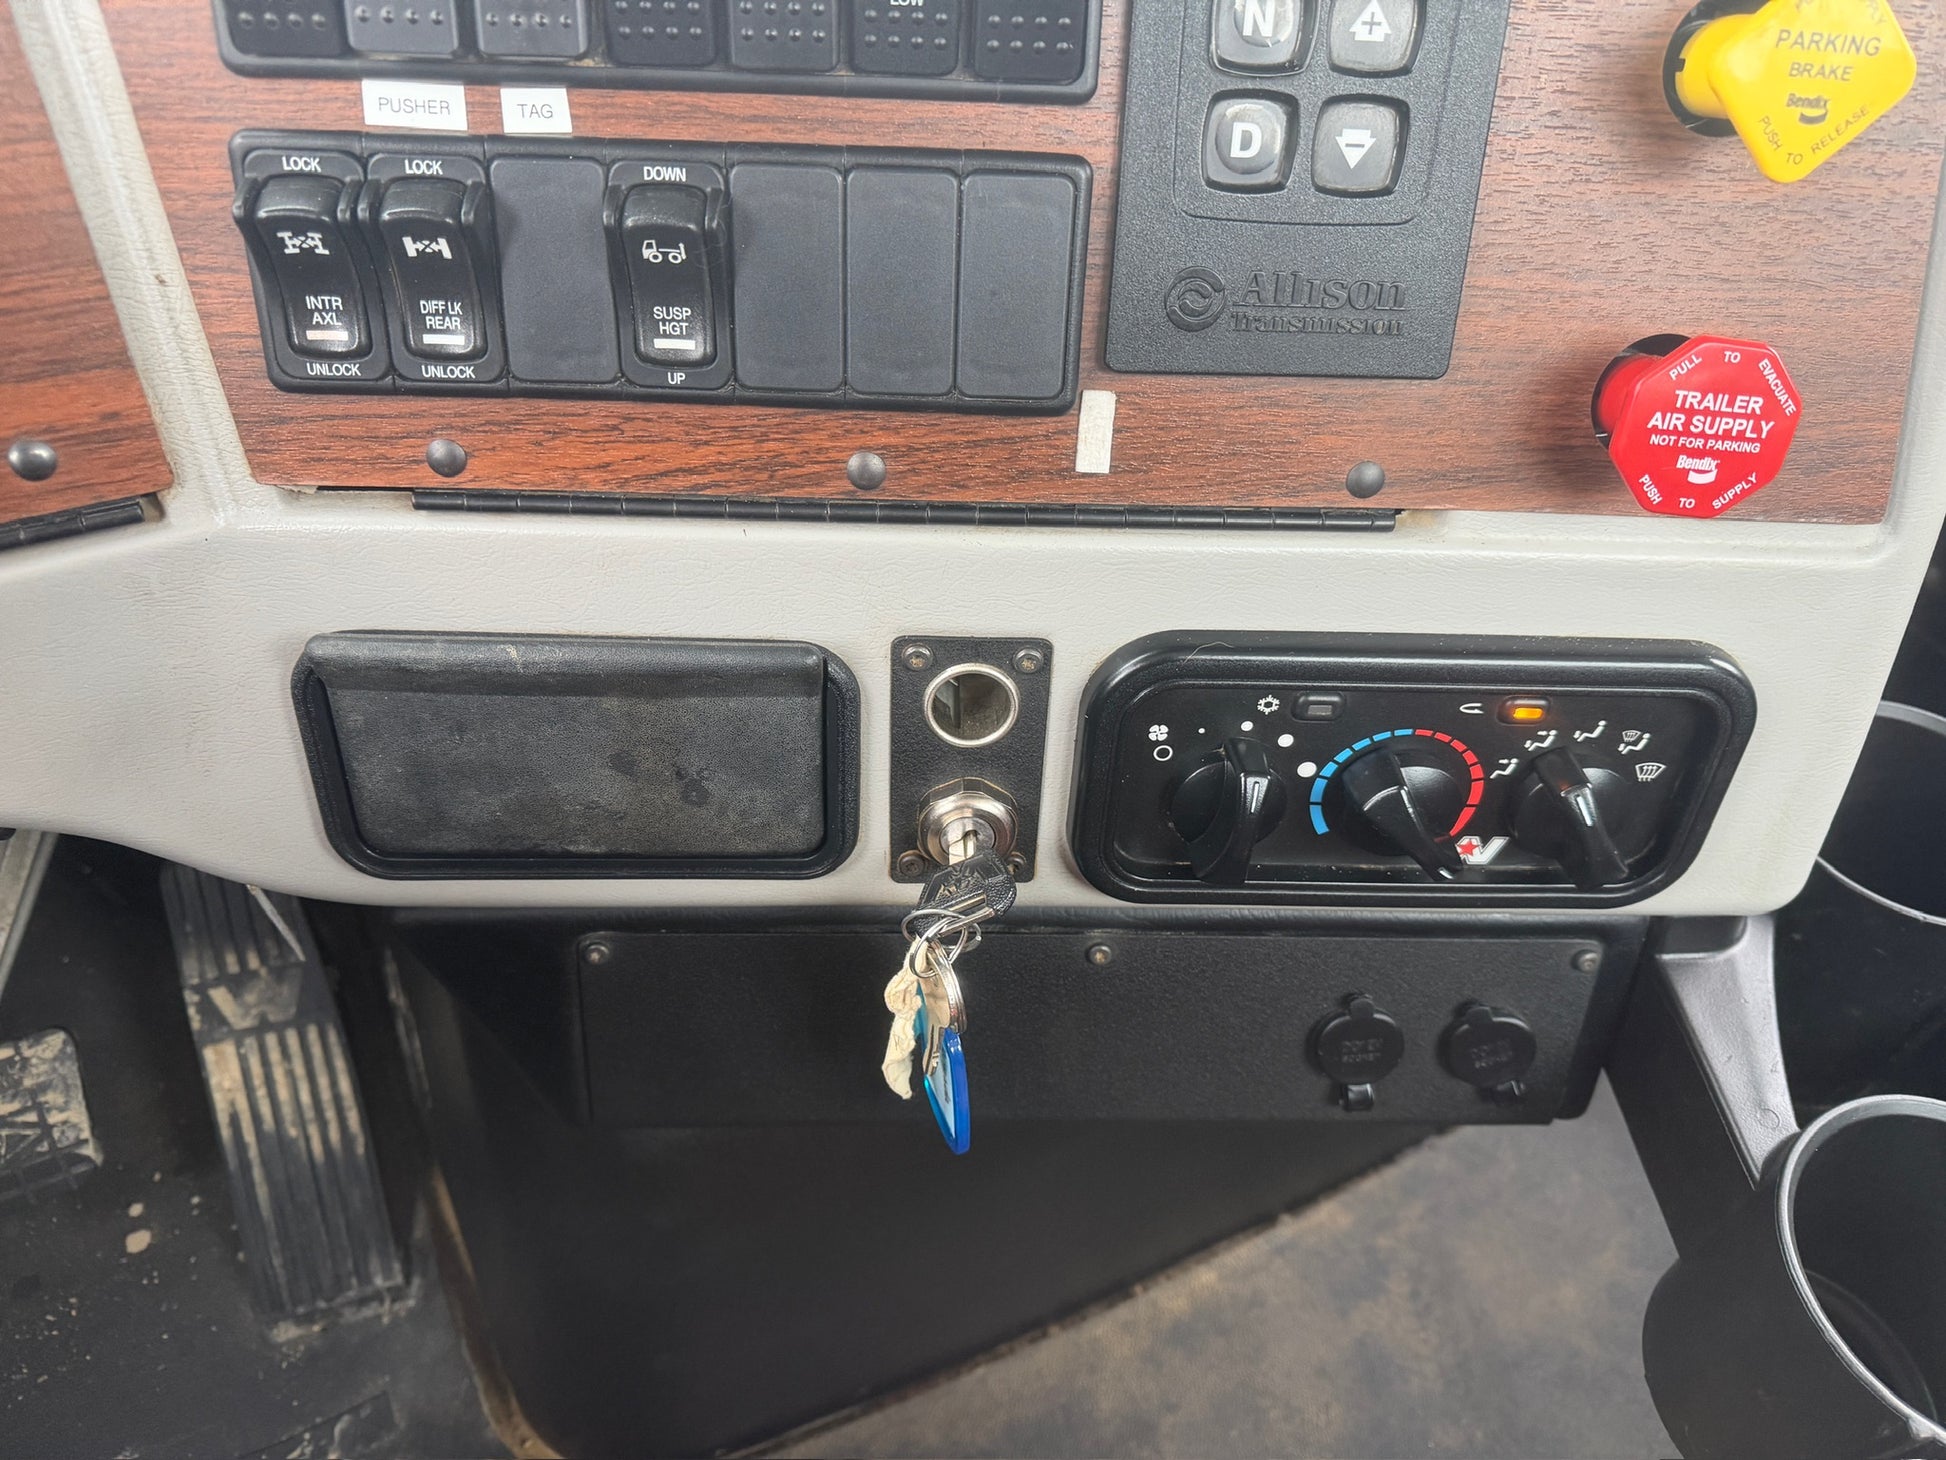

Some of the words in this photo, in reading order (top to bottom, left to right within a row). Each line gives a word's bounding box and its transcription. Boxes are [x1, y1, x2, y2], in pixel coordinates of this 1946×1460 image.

[1776, 29, 1881, 57] PARKING
[1788, 61, 1854, 82] BRAKE
[378, 96, 451, 115] PUSHER
[1785, 93, 1831, 110] Bendix
[516, 103, 554, 120] TAG
[1230, 121, 1262, 159] D
[1757, 115, 1783, 151] PUSH
[1786, 152, 1803, 165] TO
[1810, 105, 1869, 155] RELEASE
[281, 156, 322, 173] LOCK
[404, 159, 443, 176] LOCK
[643, 166, 687, 183] DOWN
[1233, 269, 1406, 311] Allison
[305, 295, 343, 311] INTR
[419, 300, 446, 315] DIFF
[448, 301, 463, 315] LK
[312, 312, 342, 326] AXL
[653, 306, 692, 320] SUSP
[425, 317, 461, 330] REAR
[659, 321, 689, 336] HGT
[1230, 311, 1402, 336] Transmission
[306, 363, 361, 377] UNLOCK
[421, 365, 476, 379] UNLOCK
[667, 372, 686, 385] UP
[1668, 353, 1702, 381] PULL
[1724, 351, 1741, 364] TO
[1758, 358, 1797, 416] EVACUATE
[1675, 389, 1764, 415] TRAILER
[1647, 411, 1686, 431] AIR
[1689, 416, 1775, 440] SUPPLY
[1649, 434, 1677, 446] NOT
[1678, 437, 1704, 449] FOR
[1705, 439, 1761, 454] PARKING
[1676, 455, 1718, 471] Bendix
[1638, 474, 1663, 505] PUSH
[1679, 497, 1696, 509] TO
[1712, 472, 1757, 510] SUPPLY
